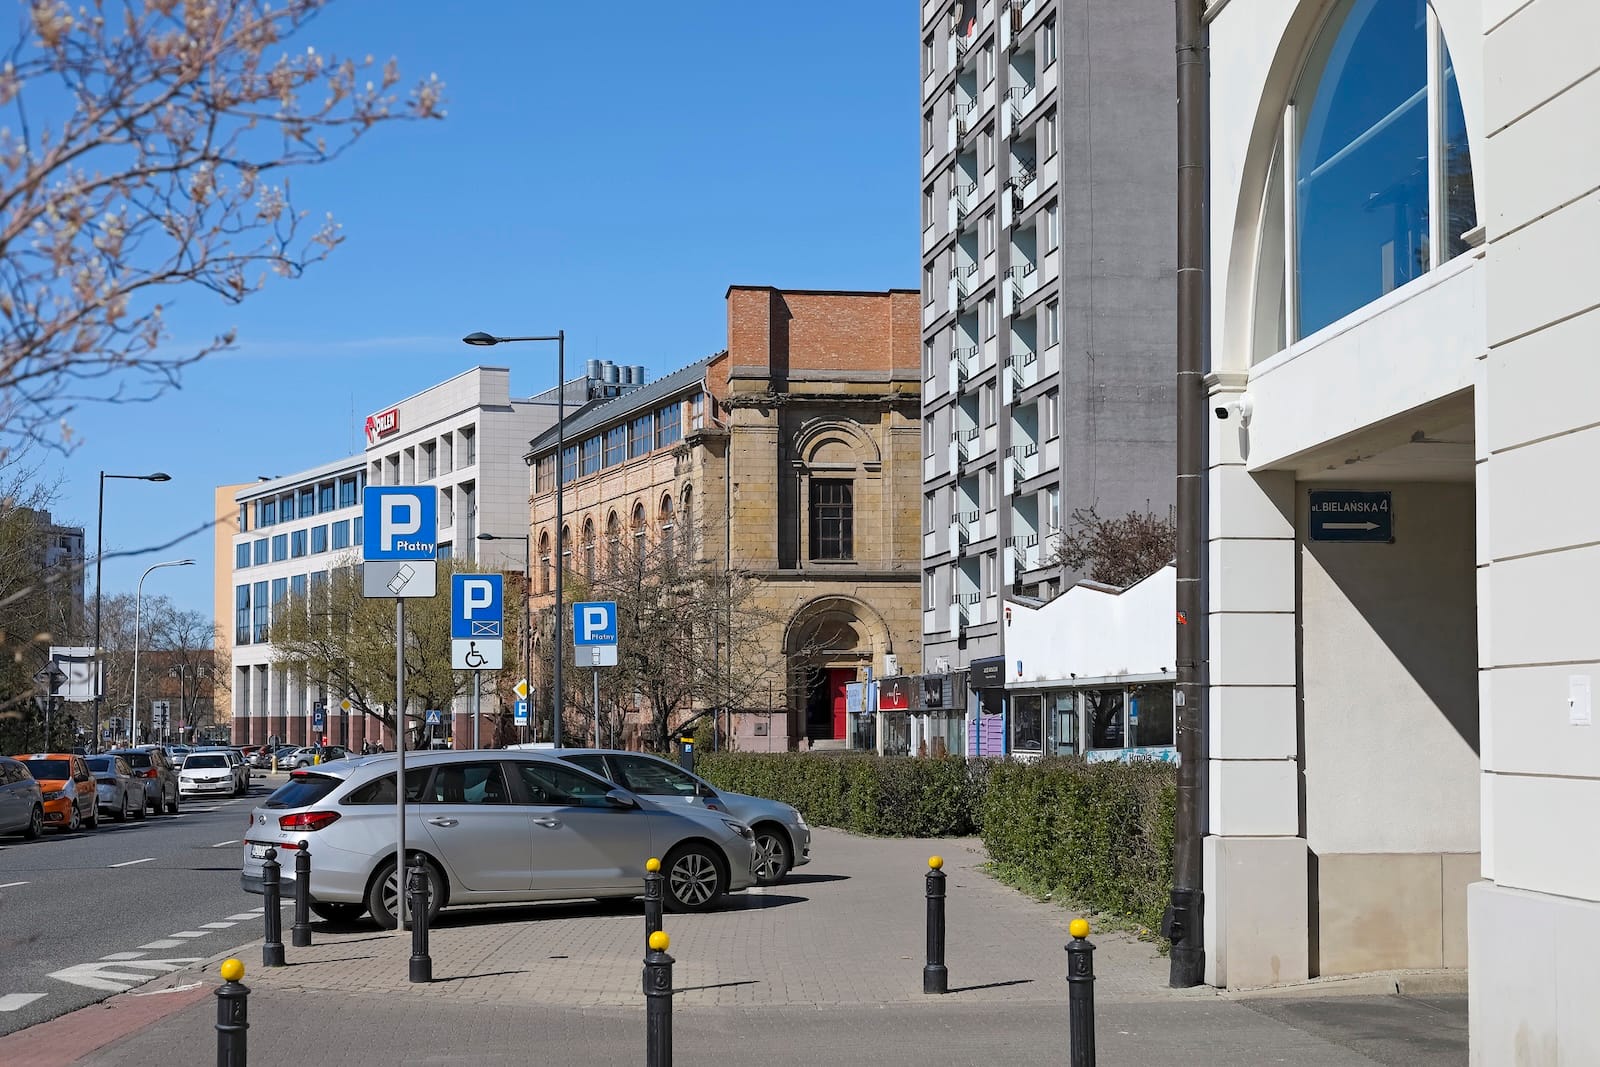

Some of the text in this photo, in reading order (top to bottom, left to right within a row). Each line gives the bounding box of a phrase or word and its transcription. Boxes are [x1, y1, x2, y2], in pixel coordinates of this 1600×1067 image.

[1322, 499, 1379, 512] BIELAŃSKA
[1379, 499, 1389, 512] 4
[381, 494, 421, 551] P
[397, 540, 434, 554] Płatny
[463, 579, 493, 620] P
[583, 606, 608, 640] P
[518, 702, 528, 716] P
[315, 713, 322, 722] P
